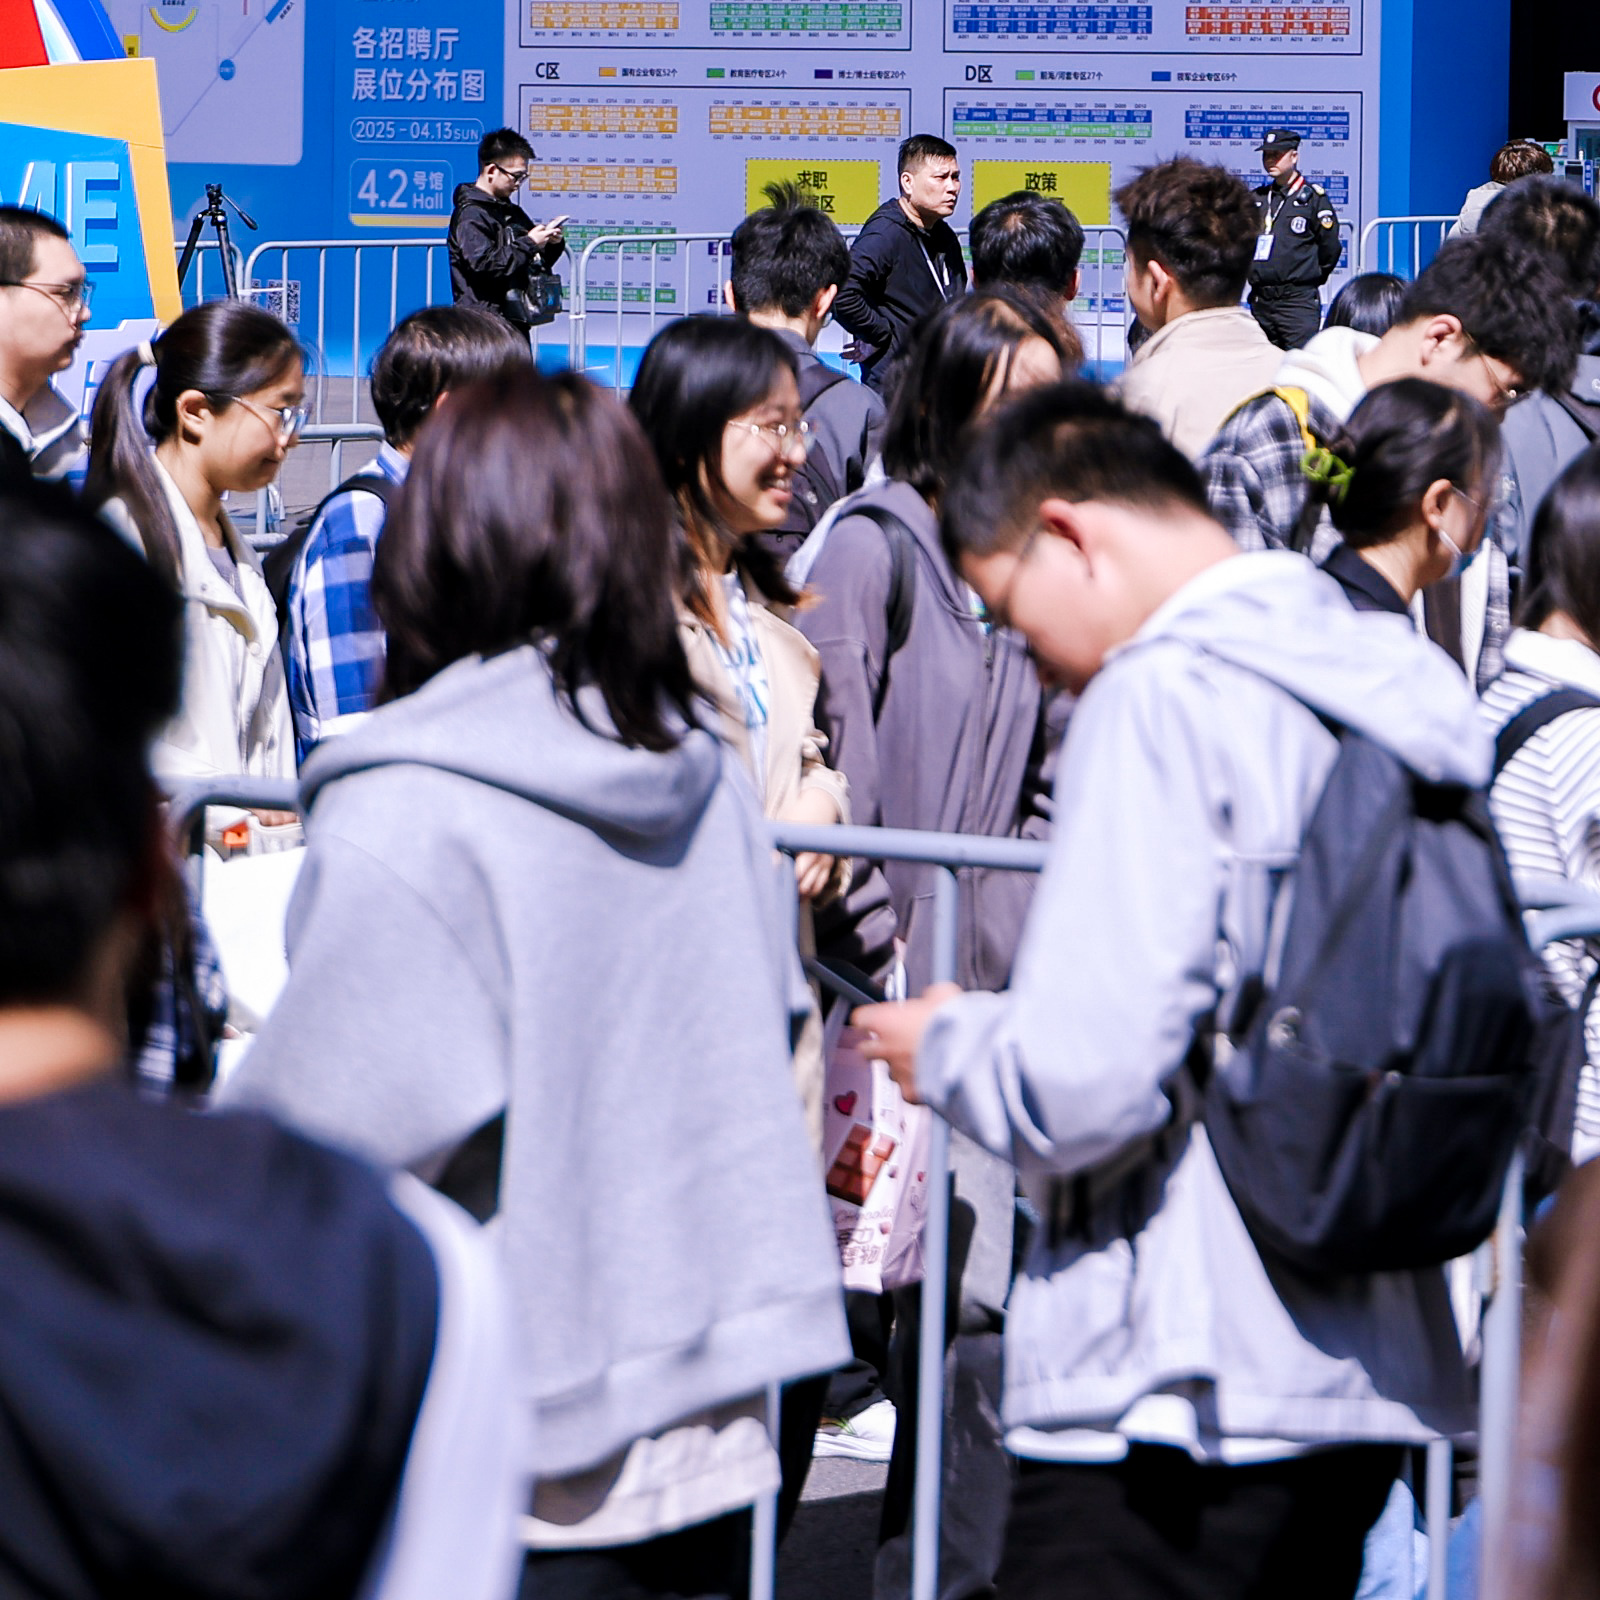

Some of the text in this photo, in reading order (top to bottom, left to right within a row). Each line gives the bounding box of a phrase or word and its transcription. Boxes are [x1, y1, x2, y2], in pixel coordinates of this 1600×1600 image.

[352, 26, 460, 61] 各招聘厅
[535, 62, 560, 80] C区
[965, 64, 993, 83] D区
[352, 68, 485, 102] 展位分布图
[357, 168, 444, 209] 4.2 号馆
[797, 170, 827, 190] 求职
[1025, 172, 1057, 192] 政策
[413, 193, 443, 210] Hall
